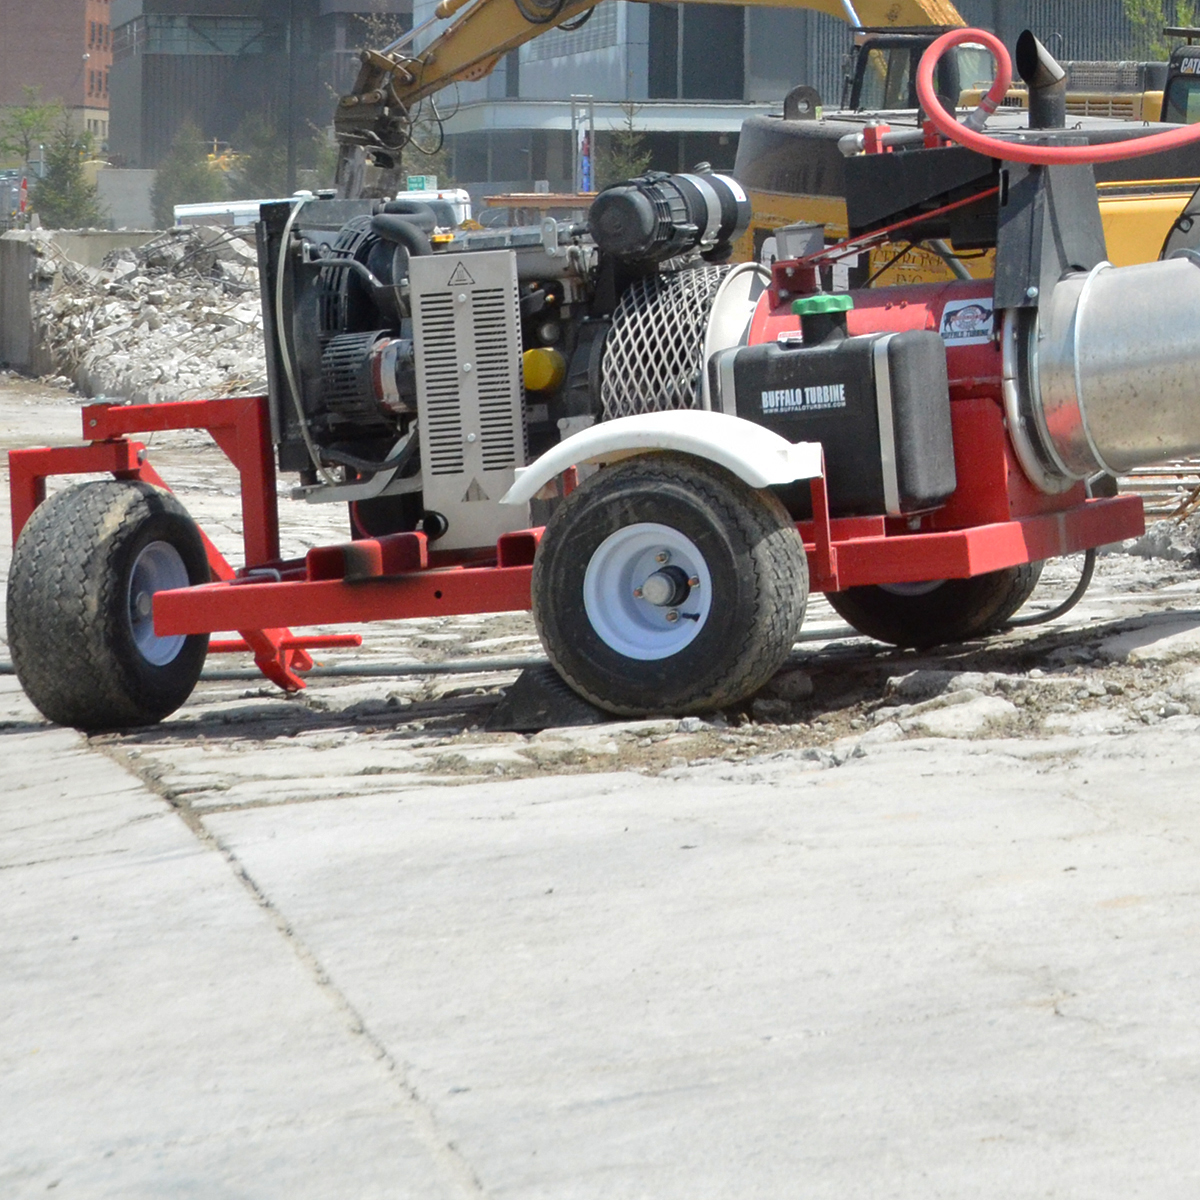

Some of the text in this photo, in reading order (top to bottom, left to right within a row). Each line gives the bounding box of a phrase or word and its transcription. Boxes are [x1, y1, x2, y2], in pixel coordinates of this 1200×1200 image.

[761, 383, 846, 409] BUFFALO TURBINE
[763, 401, 847, 414] WWW.BUFFALOTURBINE.COM
